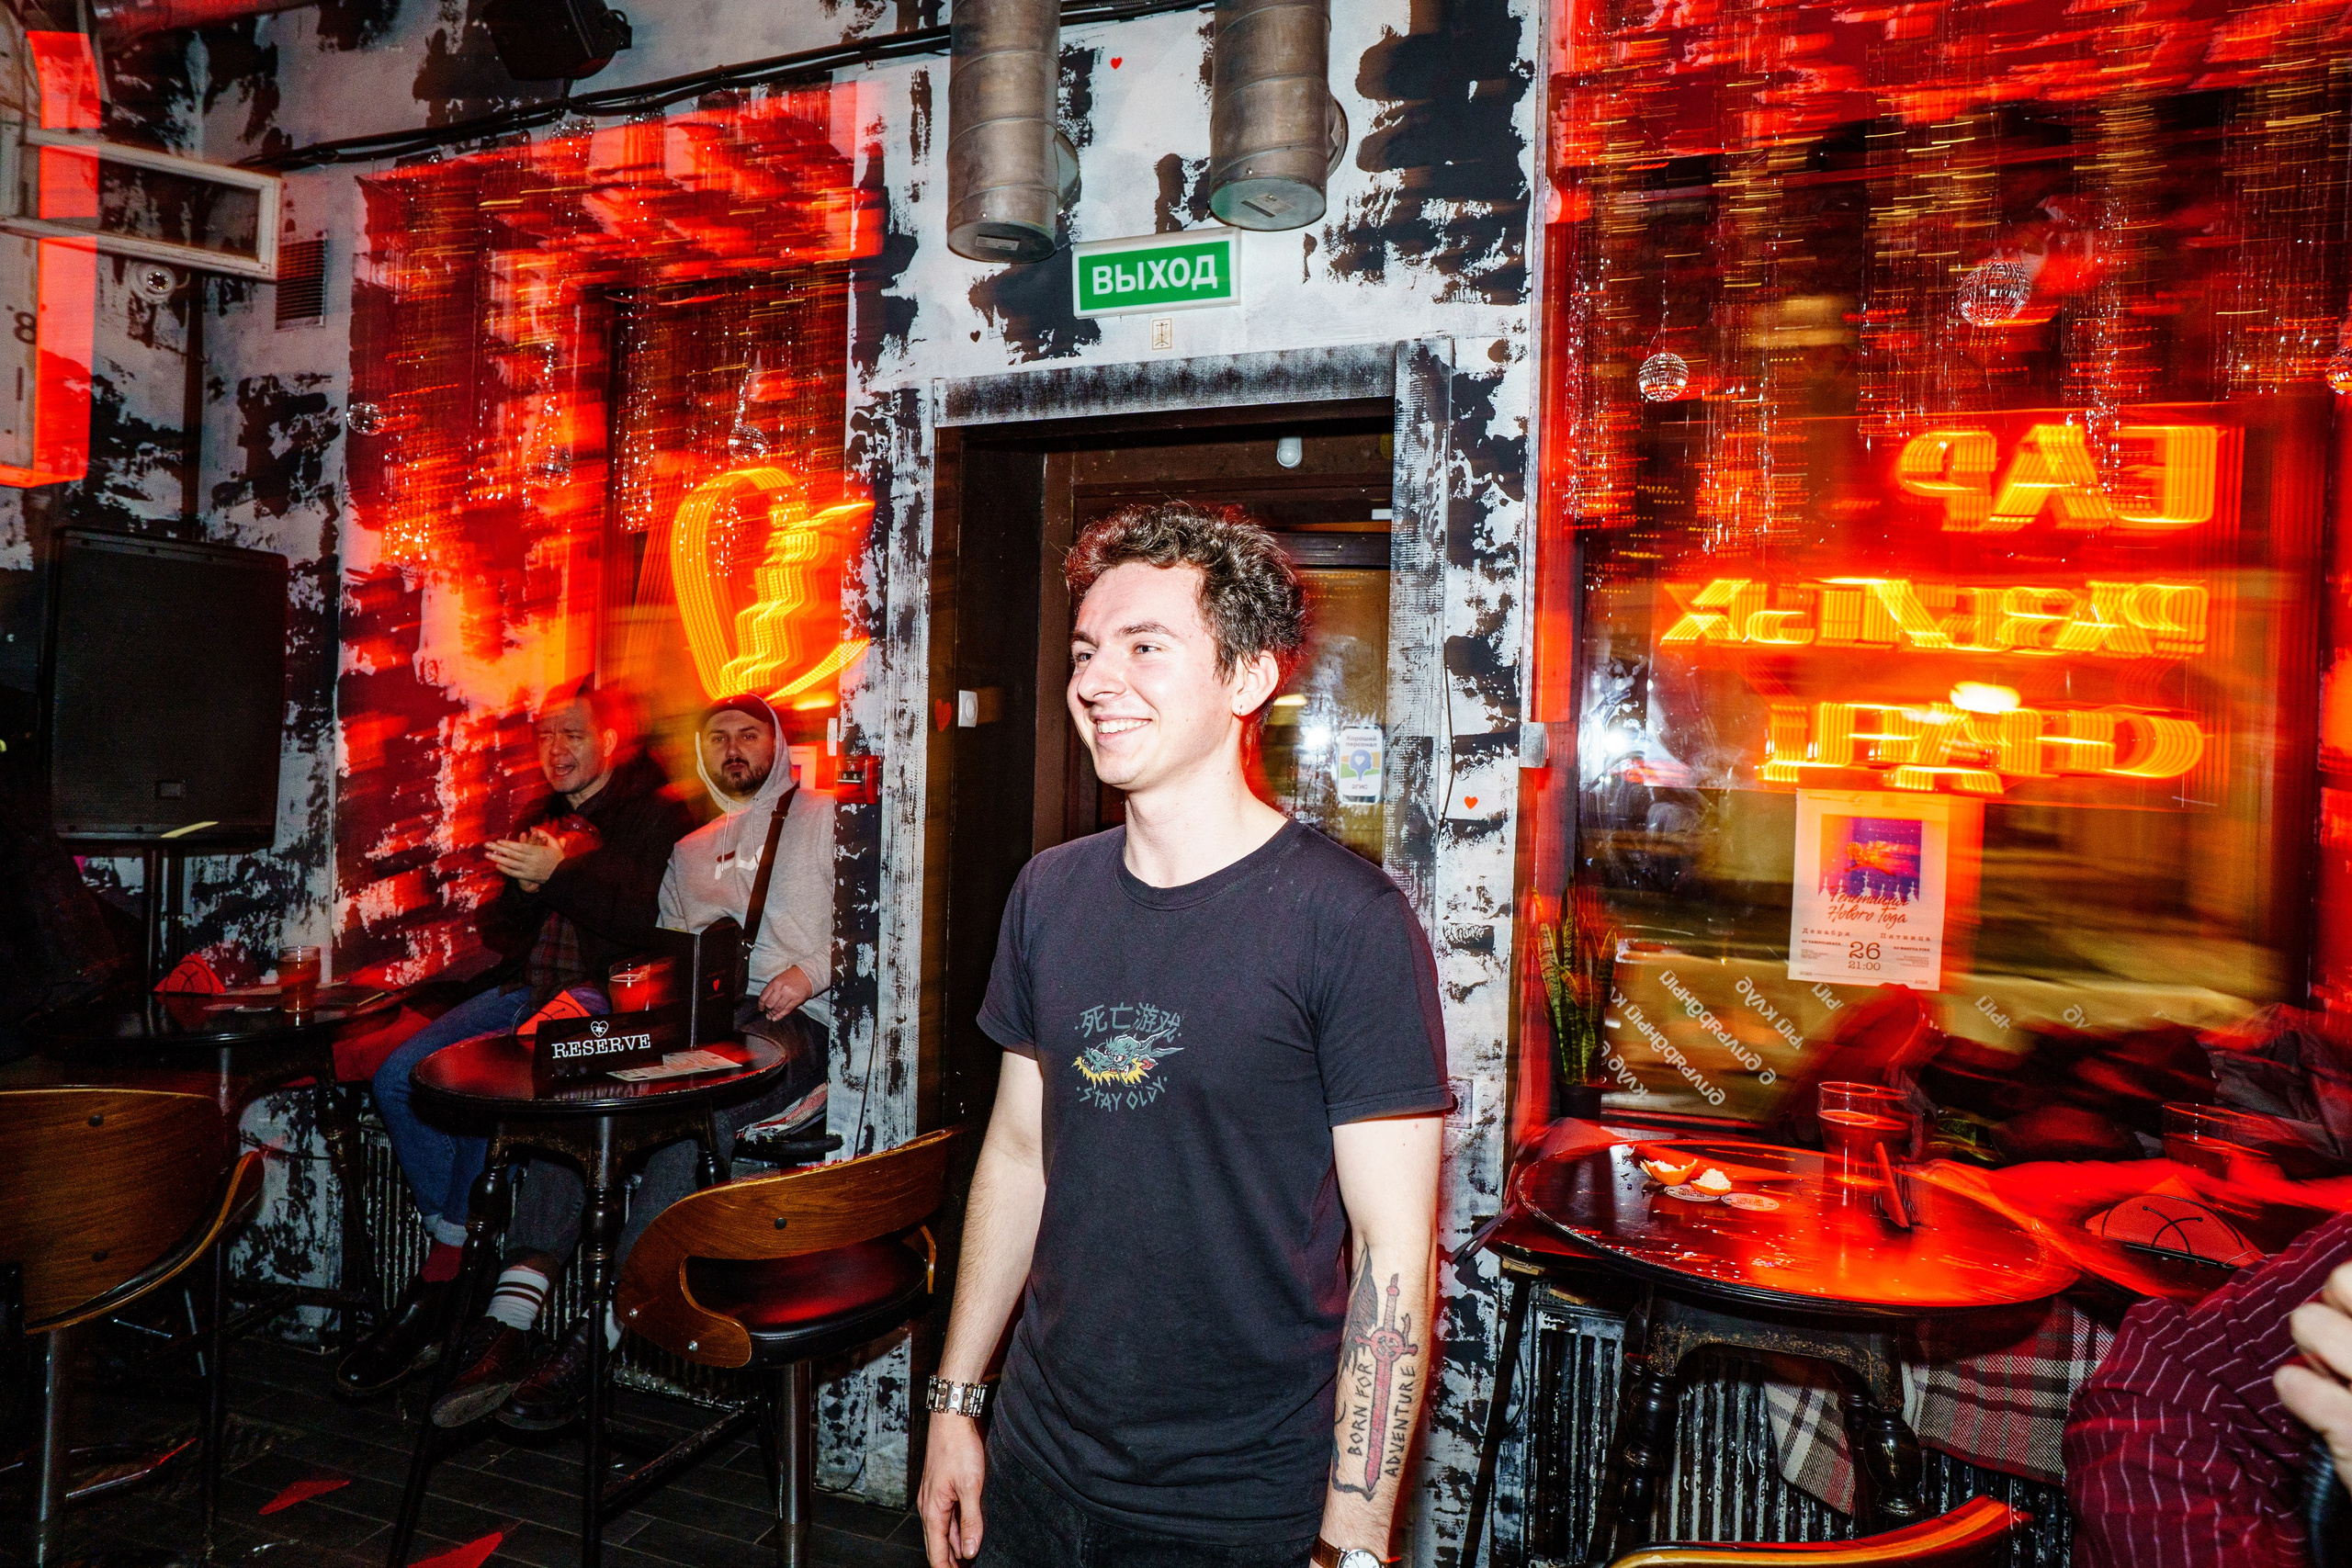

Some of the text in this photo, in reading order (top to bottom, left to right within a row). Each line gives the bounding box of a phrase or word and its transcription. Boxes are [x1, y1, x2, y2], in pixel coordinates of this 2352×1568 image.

[1092, 254, 1218, 295] ВЫХОД
[1829, 886, 1910, 907] Репетиция
[1827, 904, 1908, 930] Нового Года
[1802, 928, 1851, 937] Декабря
[1880, 932, 1931, 942] Пятница
[1849, 941, 1882, 960] 26
[1848, 960, 1882, 972] 21:00
[1080, 1002, 1181, 1043] 死亡游戏
[551, 1033, 651, 1059] RESERVE
[1080, 1087, 1122, 1112] STAY
[1347, 1362, 1374, 1457] BORN FOR
[1385, 1366, 1416, 1477] ADVENTURE
